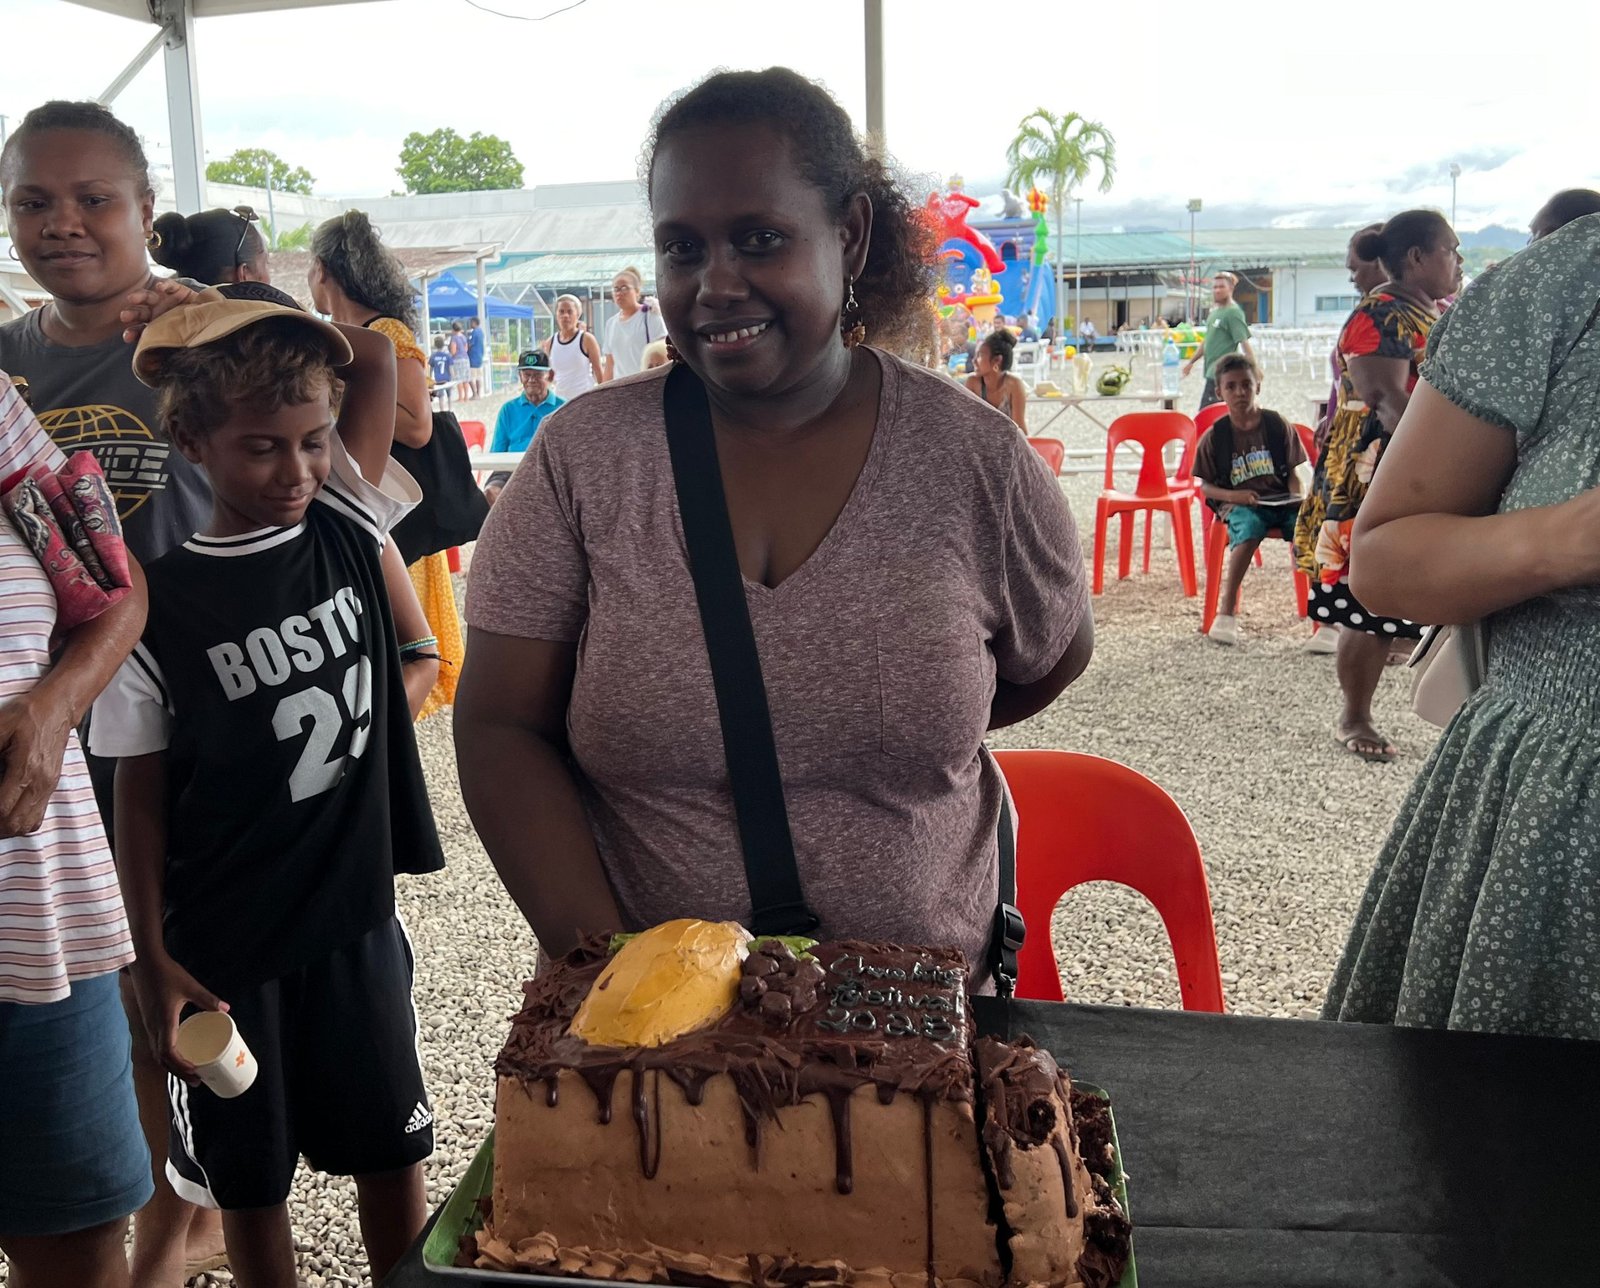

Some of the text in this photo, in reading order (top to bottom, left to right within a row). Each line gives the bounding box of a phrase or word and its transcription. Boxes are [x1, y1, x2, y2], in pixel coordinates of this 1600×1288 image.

[437, 361, 445, 375] 7
[97, 446, 170, 483] IDE.
[206, 586, 363, 702] BOSTO
[404, 1111, 433, 1134] adida
